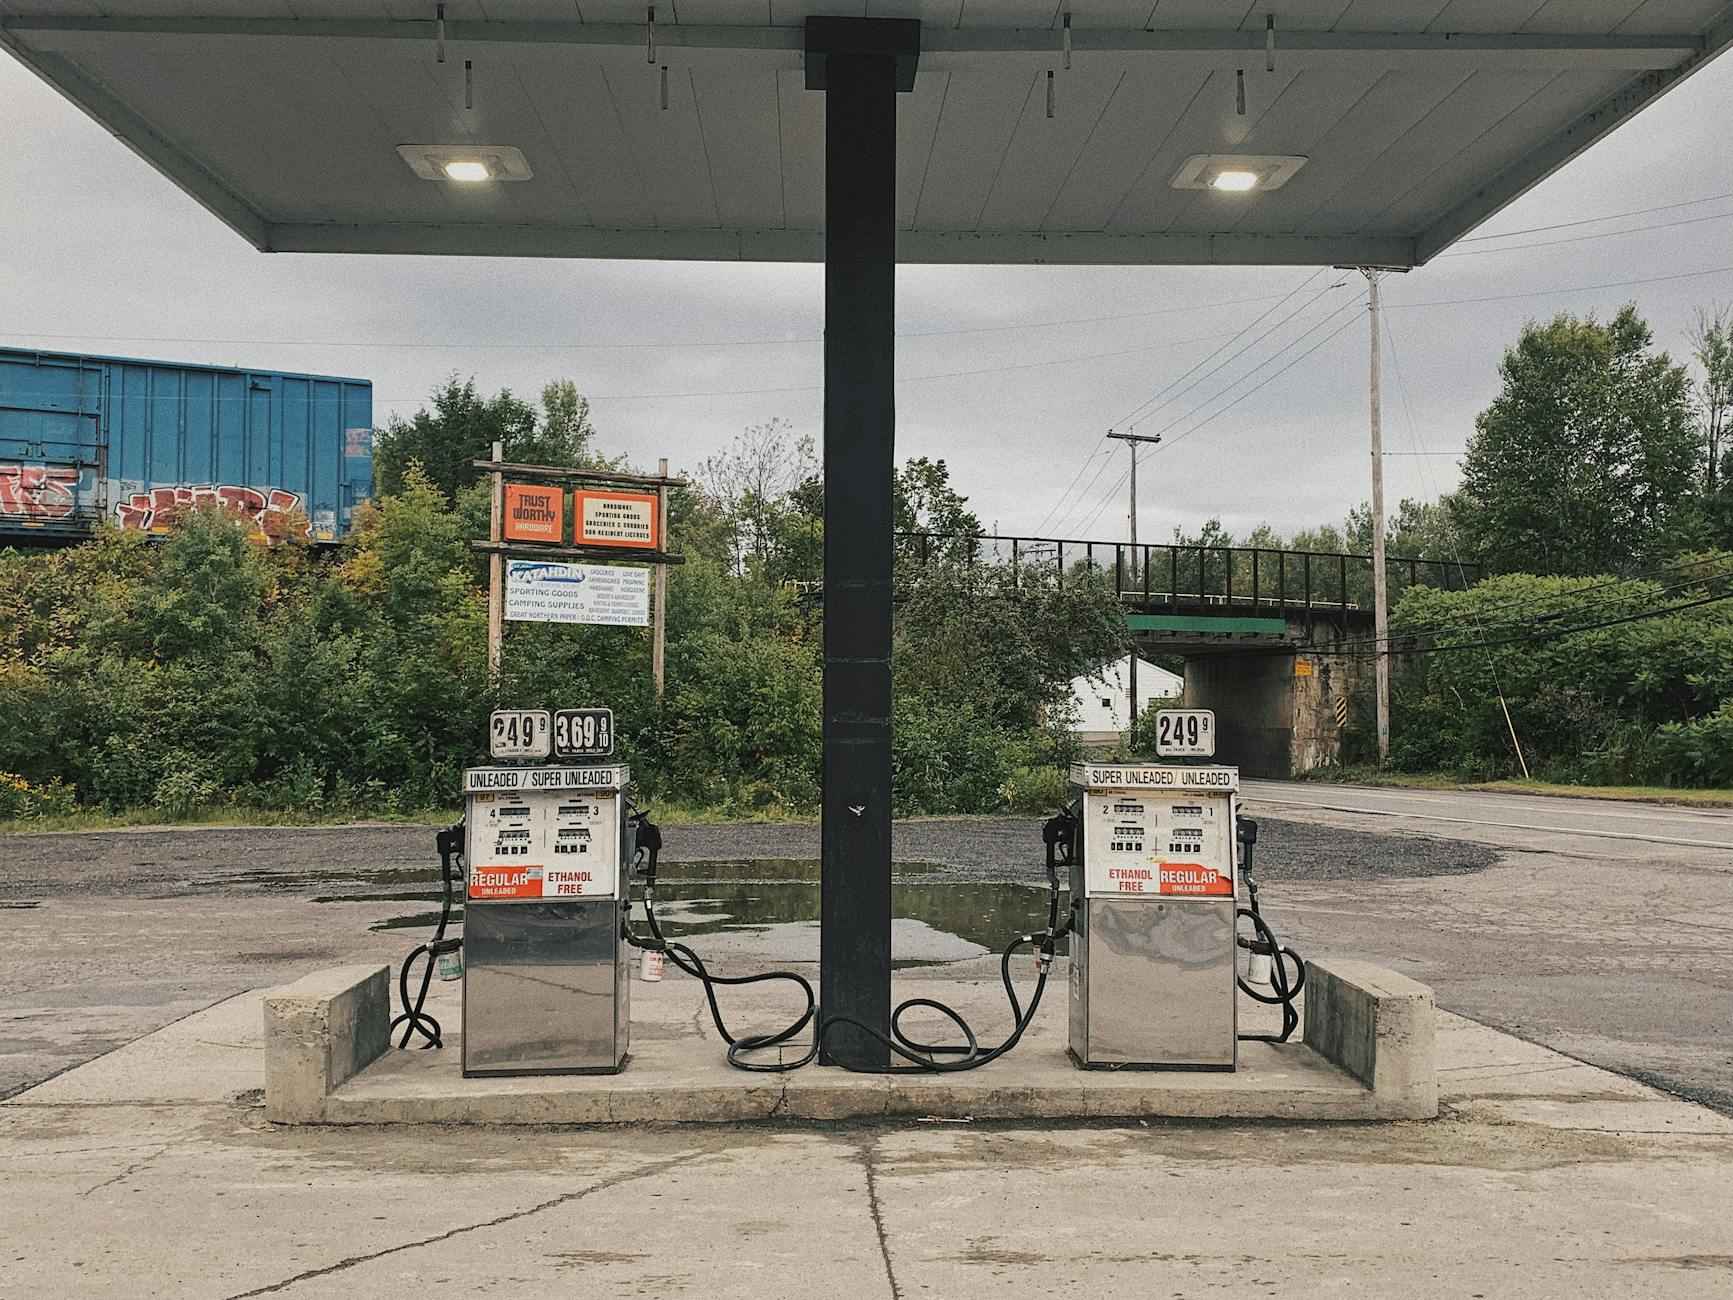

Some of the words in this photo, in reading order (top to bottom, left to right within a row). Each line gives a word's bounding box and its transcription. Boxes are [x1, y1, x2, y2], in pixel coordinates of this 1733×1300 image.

[519, 494, 551, 512] TRUST
[513, 508, 555, 522] WORTHY
[510, 588, 549, 596] SPORTING
[552, 589, 578, 598] GOODS
[509, 599, 545, 608] CAMPING
[548, 601, 585, 610] SUPPLIES
[1160, 716, 1198, 746] 249
[1202, 717, 1209, 731] 9
[470, 772, 518, 788] UNLEADED
[532, 771, 561, 787] SUPER
[565, 771, 612, 786] UNLEADED
[1092, 770, 1122, 784] SUPER
[1182, 772, 1230, 786] UNLEADED
[490, 809, 496, 818] 4
[593, 806, 599, 815] 3
[1103, 805, 1109, 814] 2
[1209, 807, 1213, 817] 1
[470, 872, 528, 887] REGULAR
[548, 872, 593, 882] ETHANOL
[1109, 869, 1153, 880] ETHANOL
[1161, 871, 1217, 884] REGULAR
[482, 887, 517, 896] UNLEADED
[557, 884, 583, 894] FREE
[1119, 881, 1144, 892] FREE
